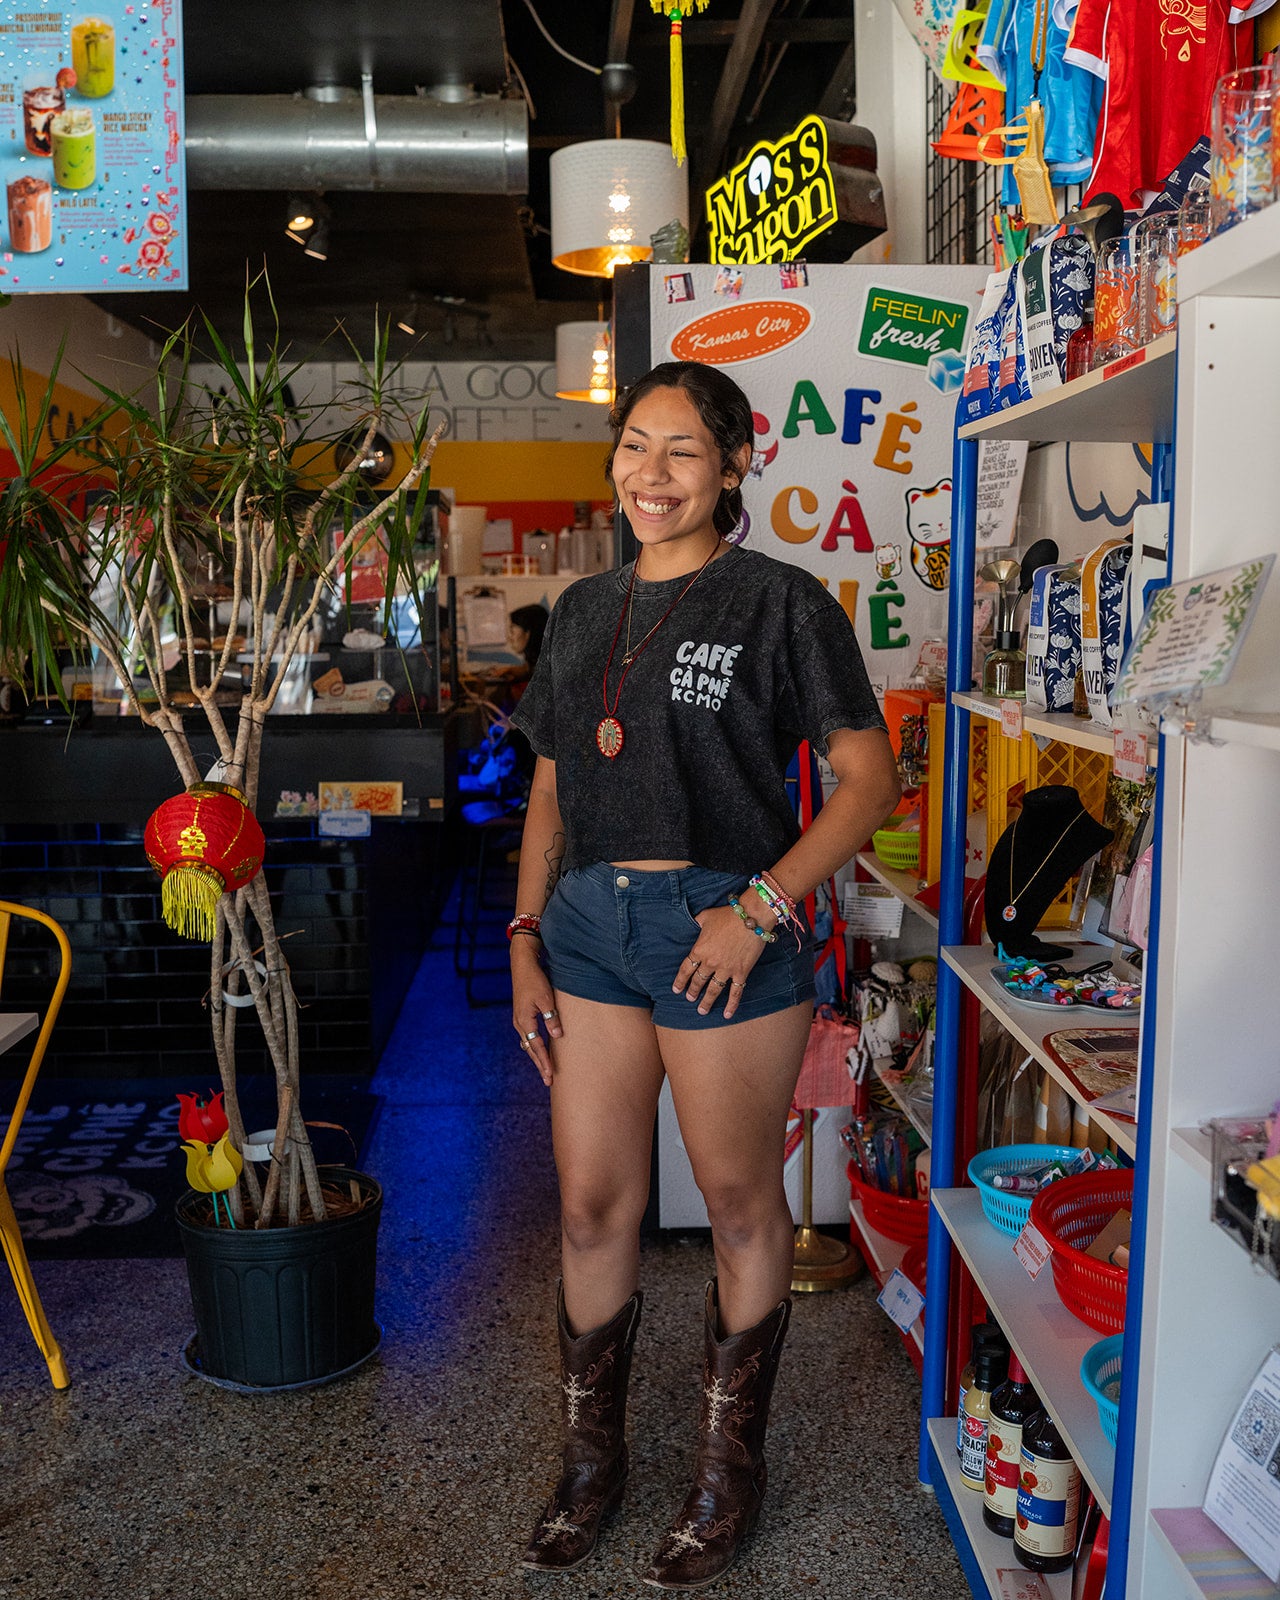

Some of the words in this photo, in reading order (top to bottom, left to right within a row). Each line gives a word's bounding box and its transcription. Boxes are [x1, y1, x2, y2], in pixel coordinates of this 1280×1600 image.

[871, 297, 962, 328] FEELIN'
[688, 328, 750, 352] Kansas
[755, 315, 792, 338] City
[869, 319, 942, 353] fresh
[770, 479, 874, 554] CÀ
[676, 641, 743, 676] CAFÉ
[670, 665, 693, 688] CÀ
[697, 673, 731, 699] PHÊ
[671, 686, 722, 712] KCMO
